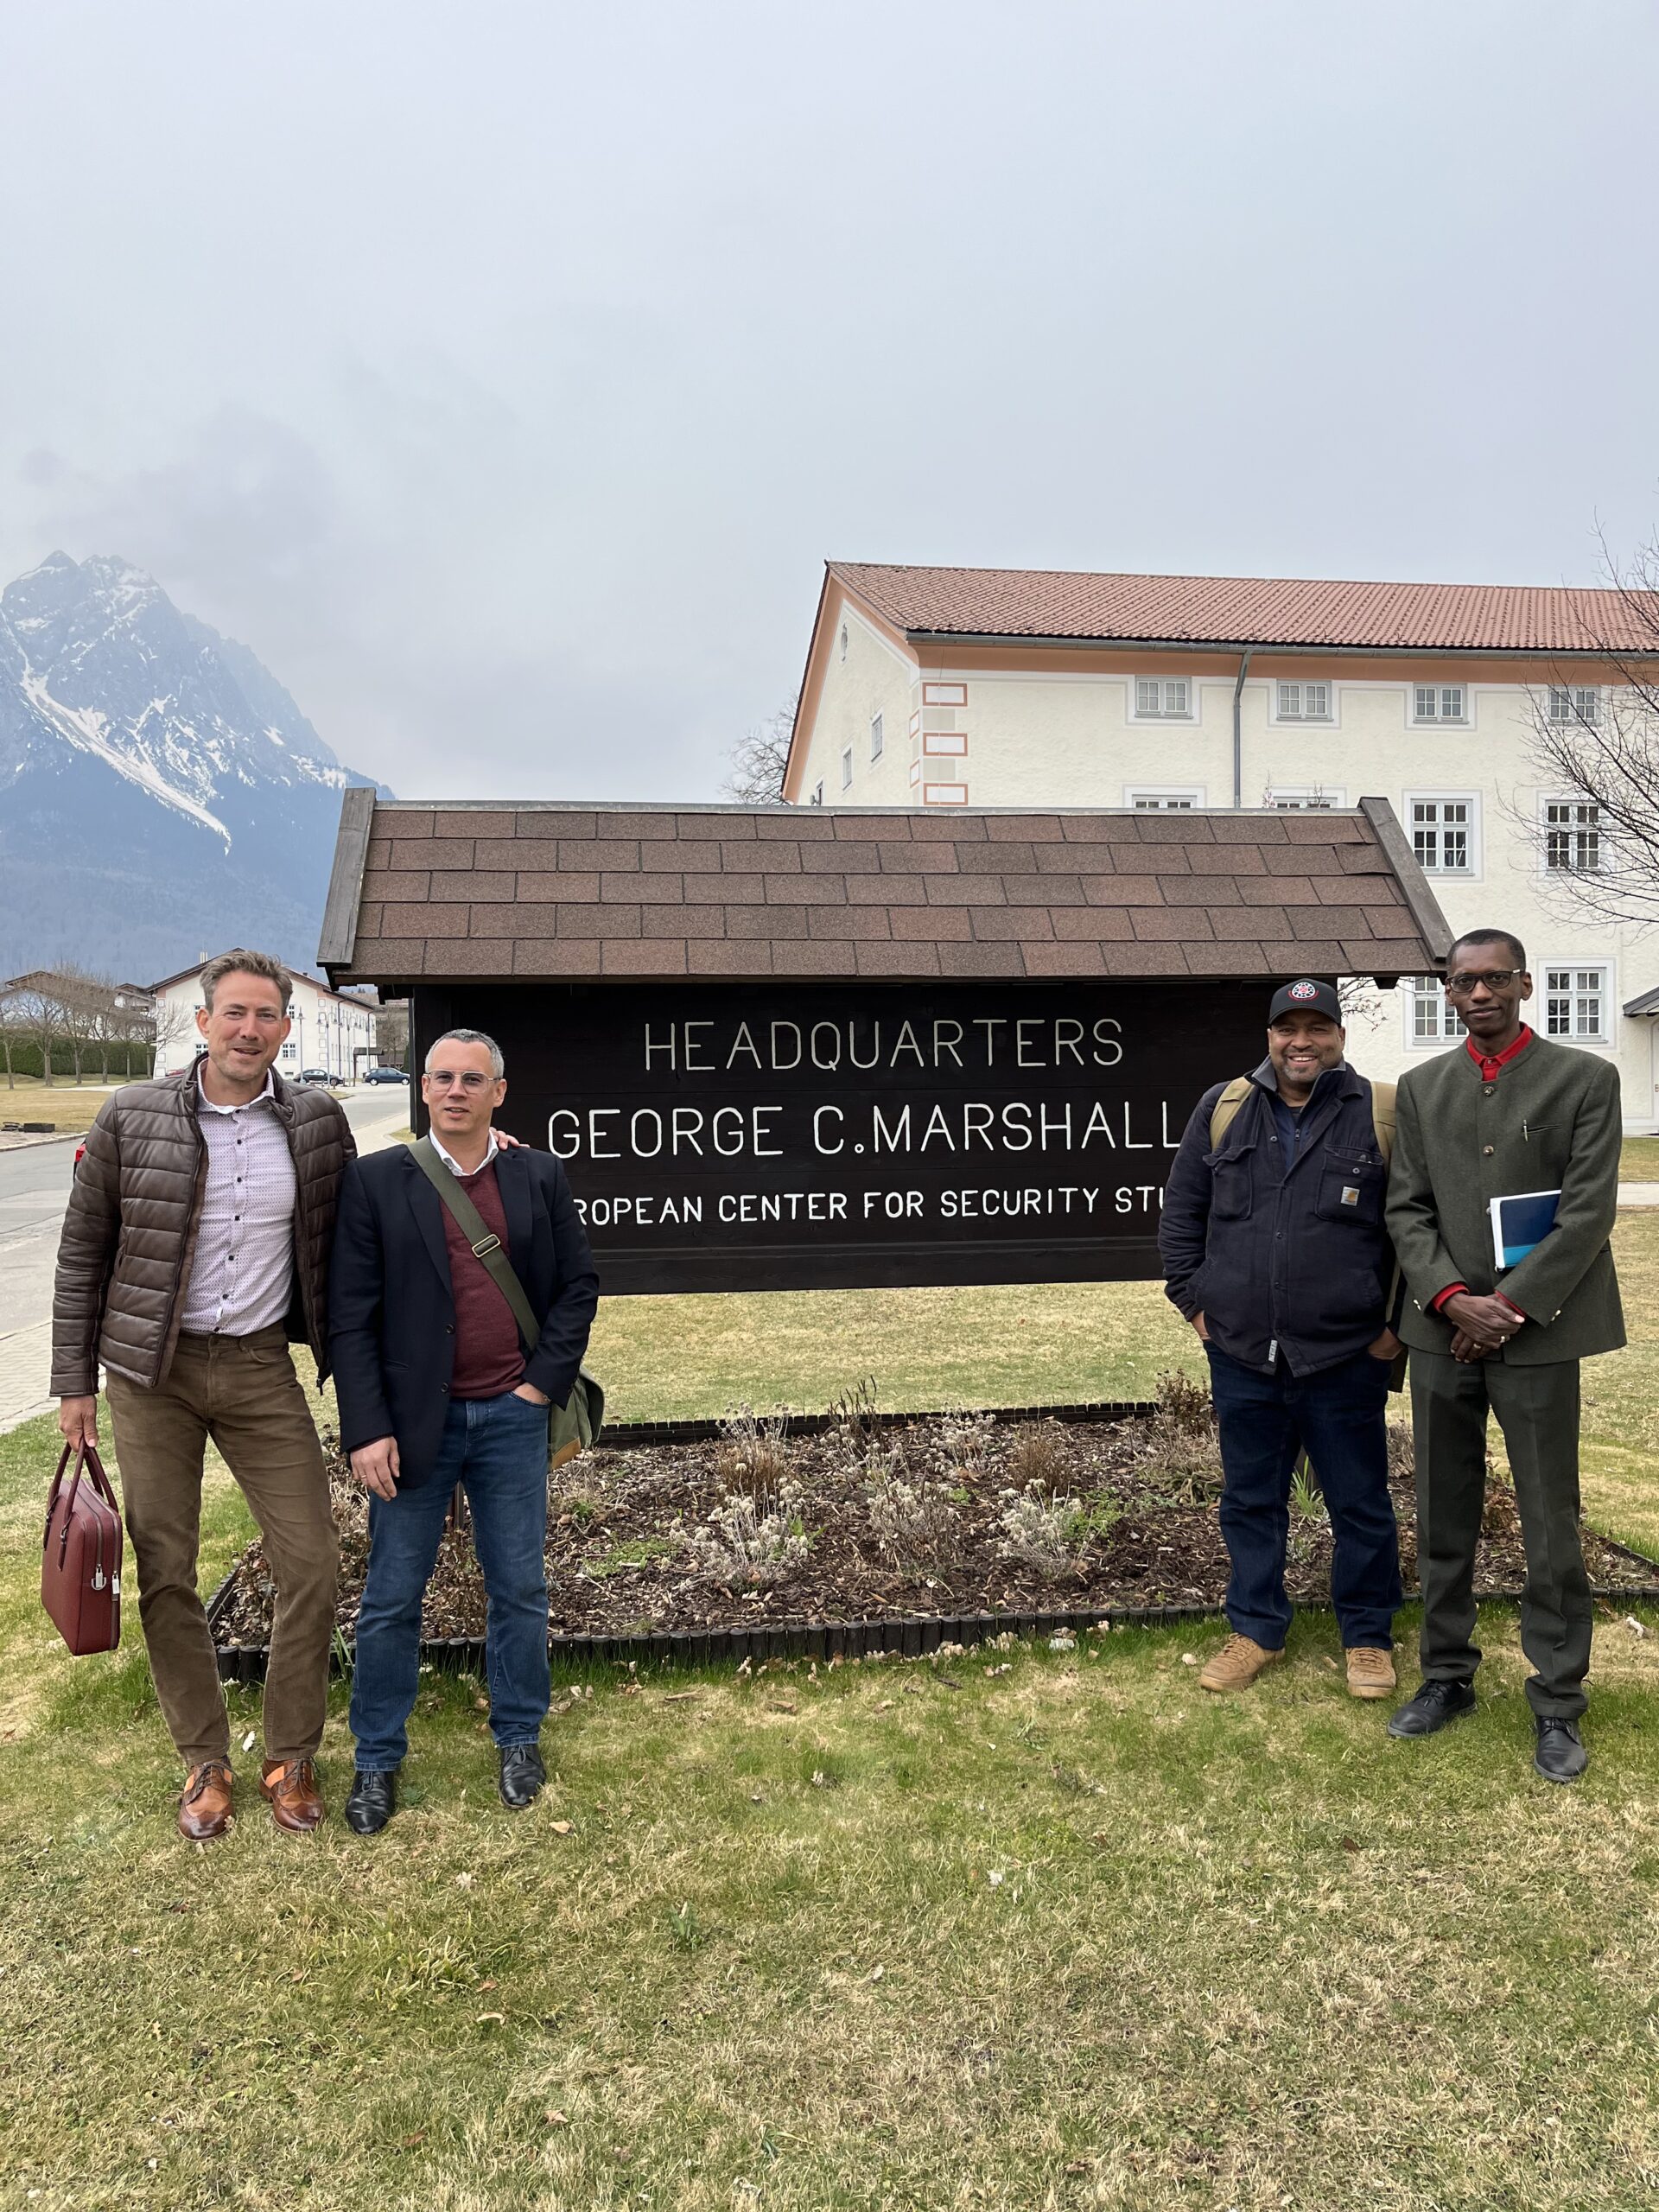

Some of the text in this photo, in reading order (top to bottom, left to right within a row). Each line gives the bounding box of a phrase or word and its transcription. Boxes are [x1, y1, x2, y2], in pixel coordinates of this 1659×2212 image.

[645, 1015, 1124, 1071] HEADQUARTERS
[548, 1106, 784, 1159] GEORGE
[573, 1196, 702, 1226] ROPEAN
[718, 1192, 848, 1224] CENTER
[863, 1190, 925, 1220] FOR
[940, 1186, 1100, 1217] SECURITY
